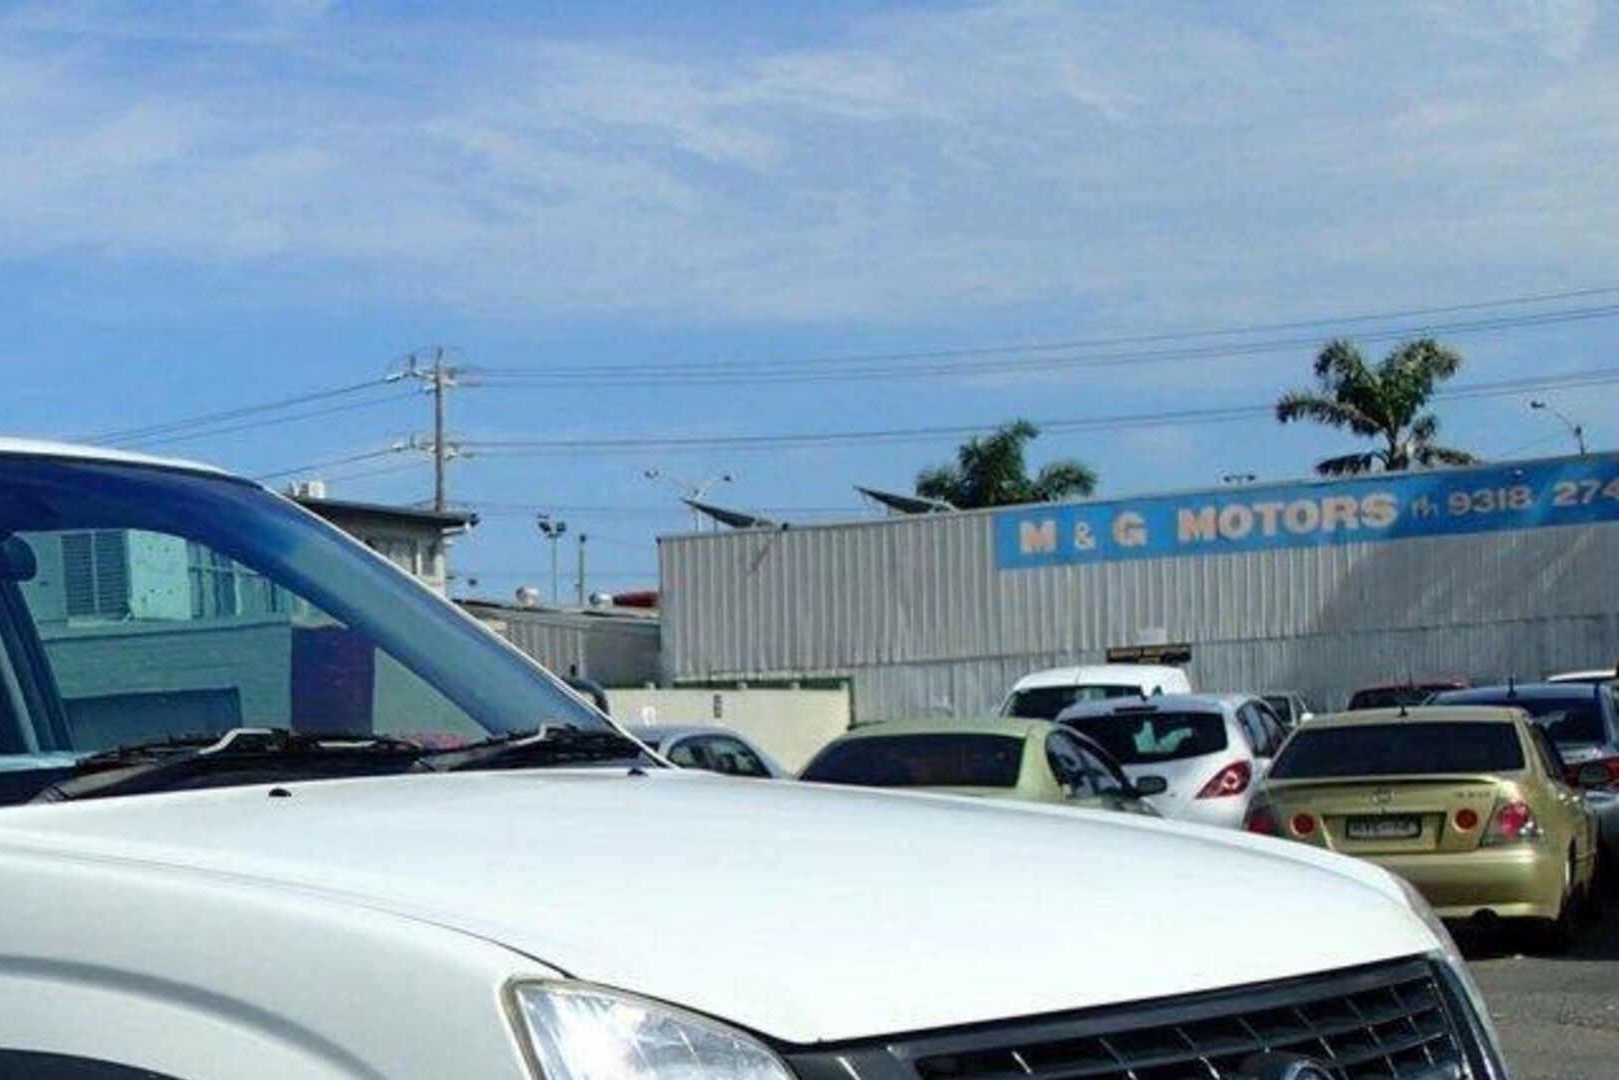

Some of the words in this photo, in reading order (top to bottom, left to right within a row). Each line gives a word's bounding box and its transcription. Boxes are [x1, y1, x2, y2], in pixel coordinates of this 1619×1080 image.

[1019, 520, 1056, 554] M
[1073, 521, 1097, 550] &
[1112, 512, 1148, 547] G
[1177, 491, 1399, 542] MOTORS
[1448, 485, 1532, 517] 9318
